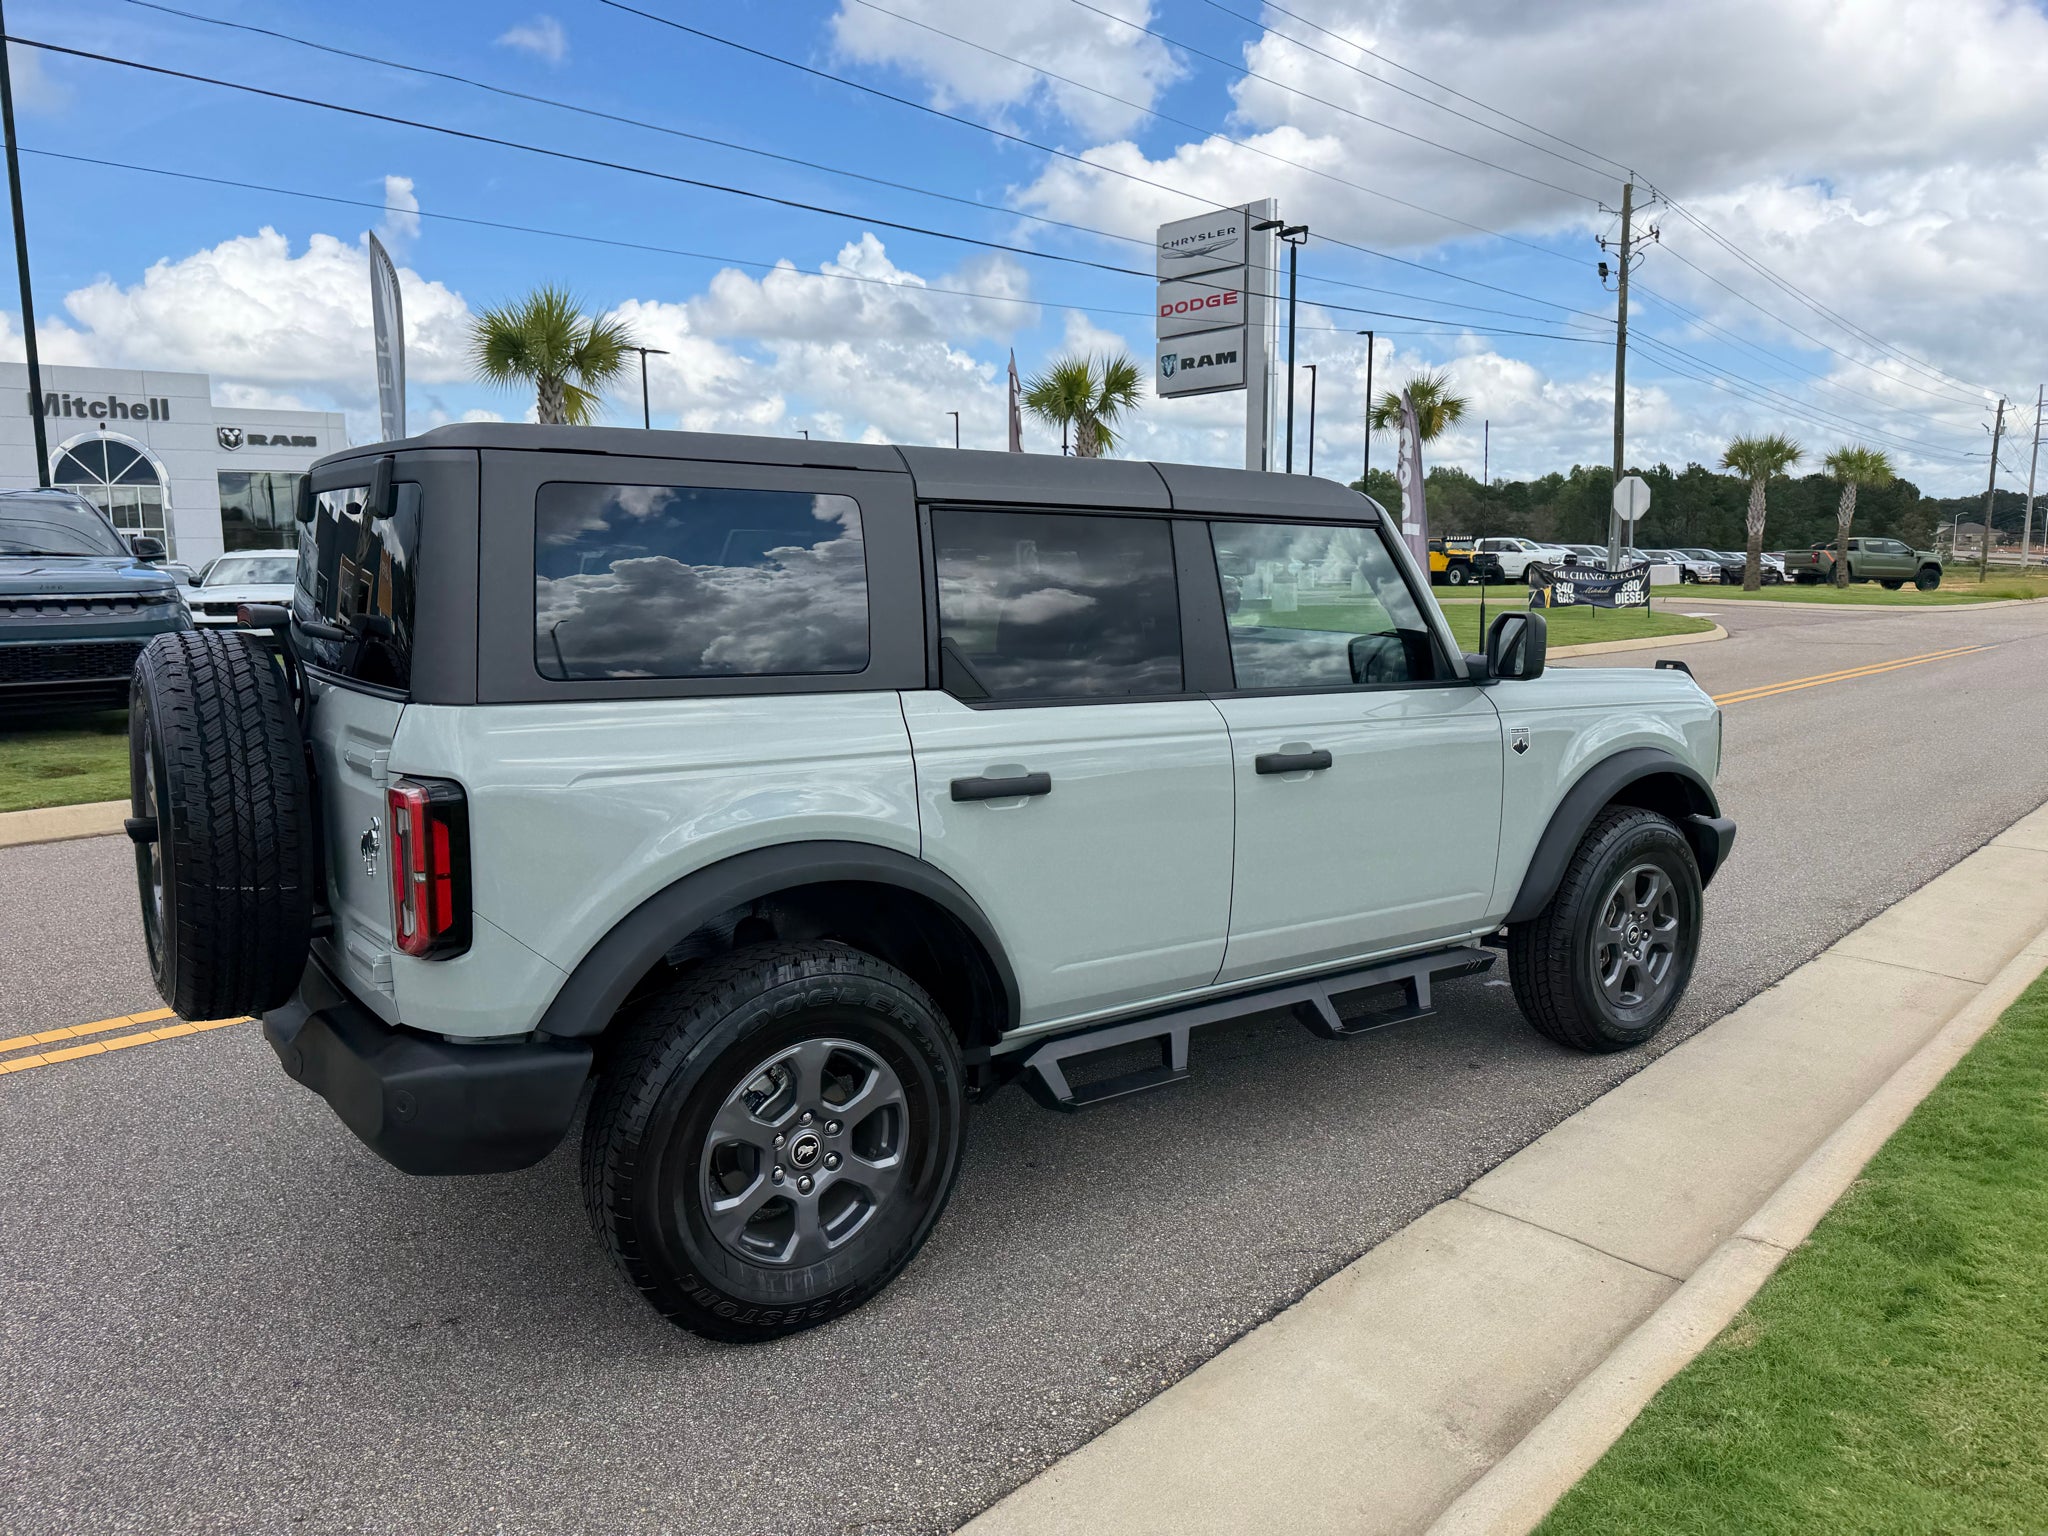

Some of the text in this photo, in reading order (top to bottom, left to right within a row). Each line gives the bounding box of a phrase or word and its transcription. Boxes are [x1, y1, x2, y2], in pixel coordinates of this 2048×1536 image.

[1162, 226, 1236, 249] CHRYSLER
[1160, 291, 1238, 317] DODGE
[1180, 350, 1237, 371] RAM
[28, 391, 170, 421] Mitchell
[247, 433, 317, 448] RAM
[1553, 568, 1646, 581] OIL CHANGE SPECIAL
[1555, 582, 1575, 594] $40
[1557, 593, 1576, 604] GAS
[1615, 591, 1646, 604] DIESEL
